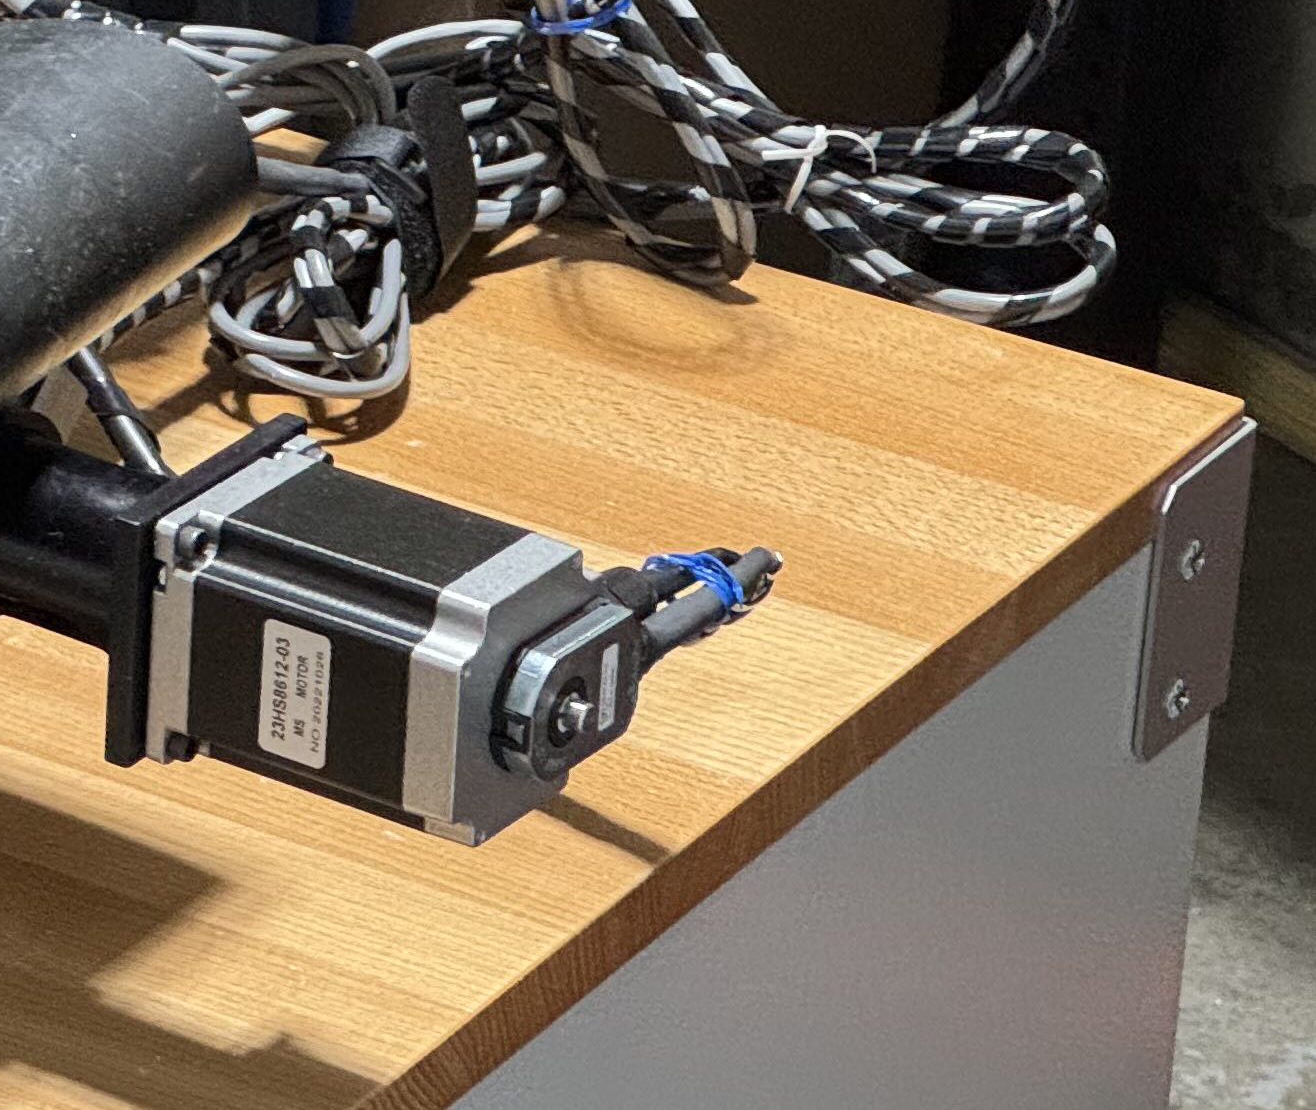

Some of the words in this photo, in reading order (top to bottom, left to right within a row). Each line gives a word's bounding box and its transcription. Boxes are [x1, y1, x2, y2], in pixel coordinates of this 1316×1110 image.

[271, 637, 291, 741] 23HS8612-03
[295, 655, 309, 699] MOTOR
[293, 719, 306, 737] MS
